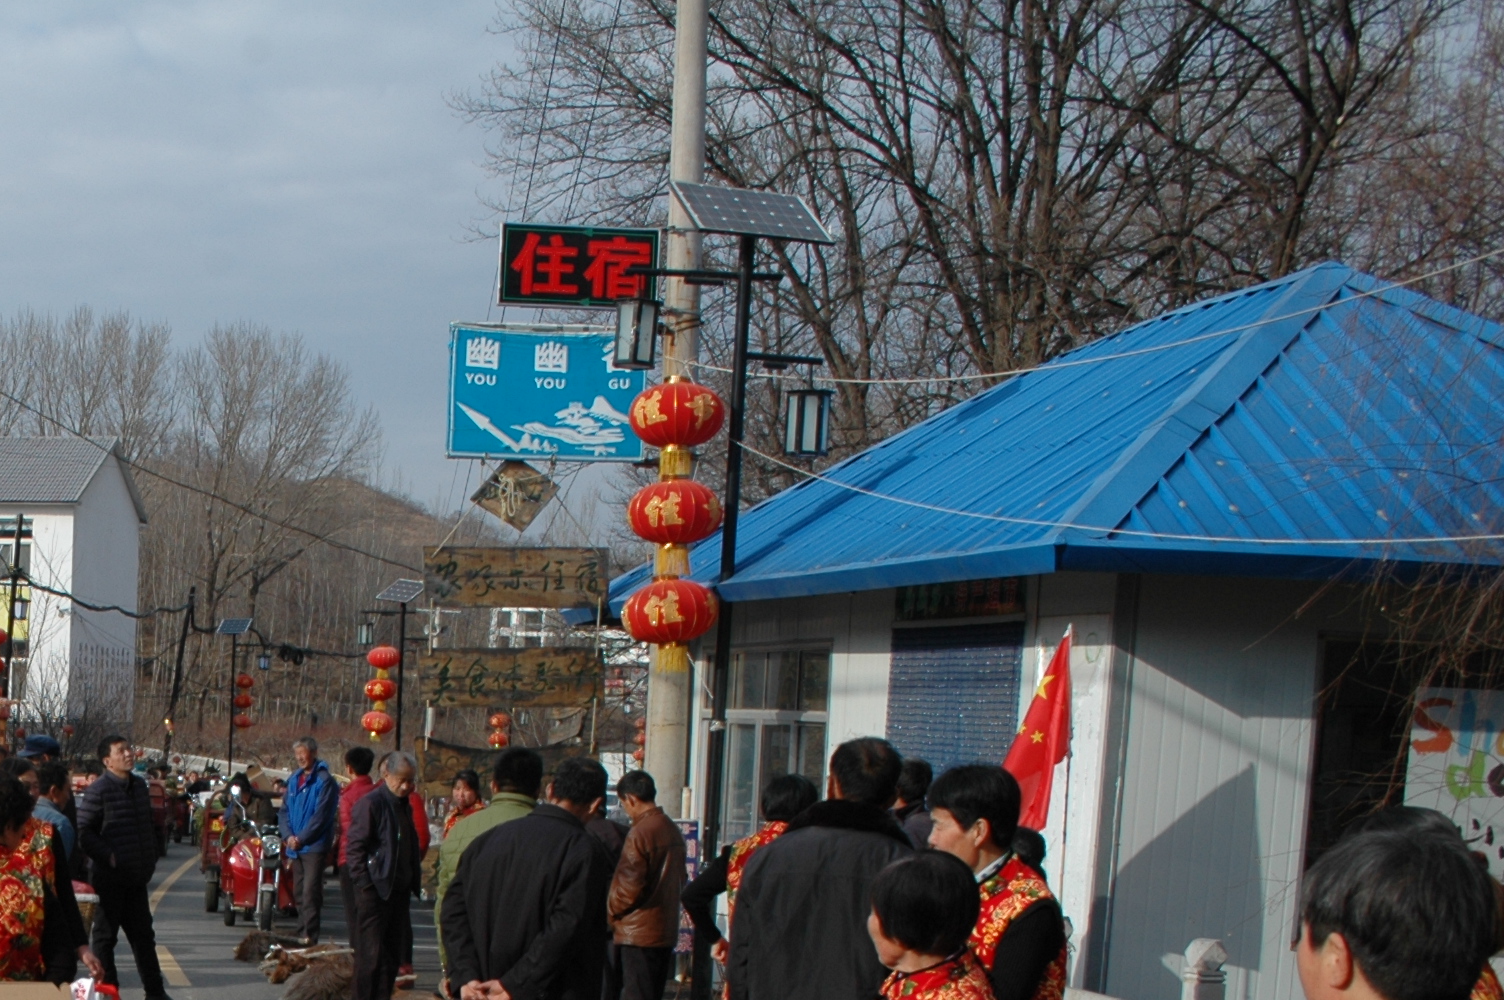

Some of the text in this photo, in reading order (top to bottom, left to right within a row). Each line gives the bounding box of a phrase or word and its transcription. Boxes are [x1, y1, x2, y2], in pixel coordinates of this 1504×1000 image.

[511, 232, 651, 299] 住宿
[465, 372, 631, 390] YOU YOU GU
